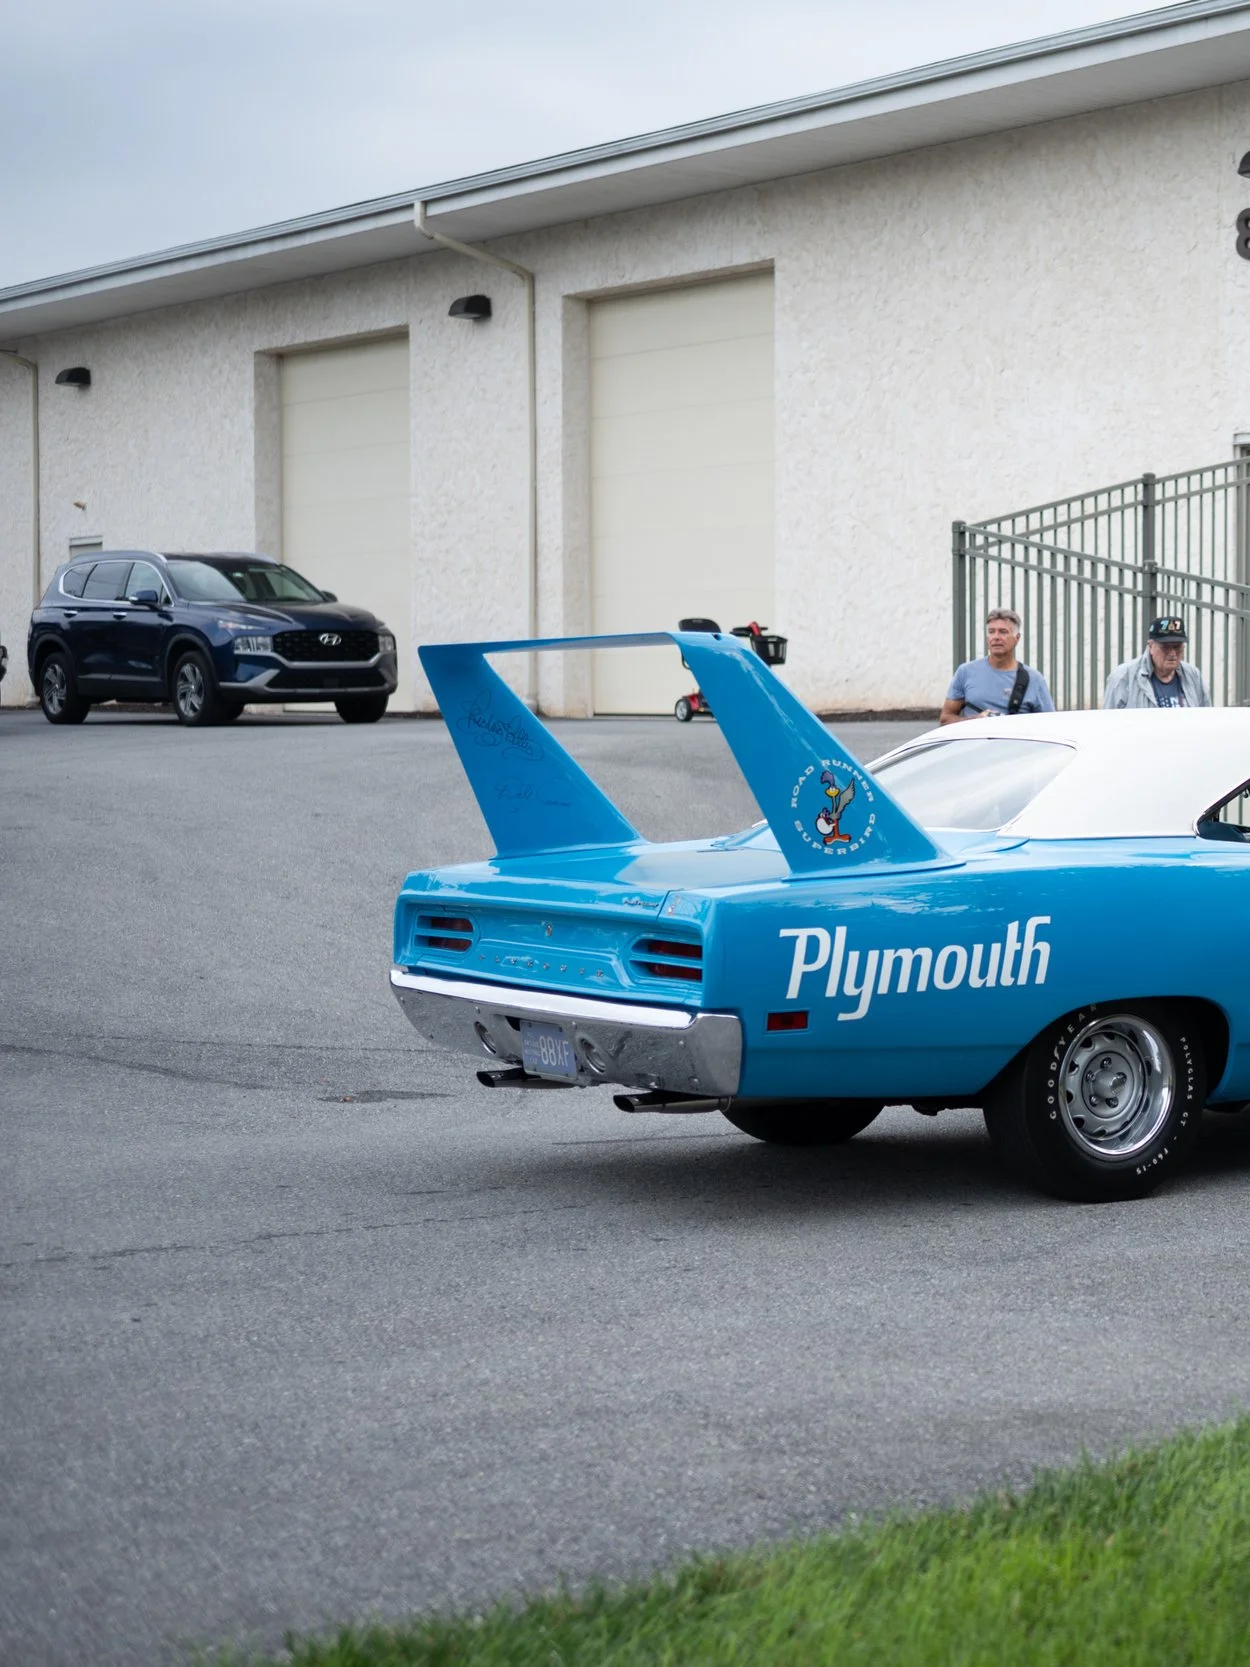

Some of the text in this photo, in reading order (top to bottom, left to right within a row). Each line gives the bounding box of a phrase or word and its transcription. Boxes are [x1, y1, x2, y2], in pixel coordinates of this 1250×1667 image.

[791, 759, 874, 808] ROAD RUNNER
[794, 813, 876, 855] SUPERBIRD
[779, 916, 1051, 1021] Plymouth
[540, 1035, 569, 1068] 88XF
[1048, 1004, 1097, 1120] GOODYEAR
[1180, 1036, 1194, 1100] POLYGLAS
[1180, 1111, 1189, 1127] GT
